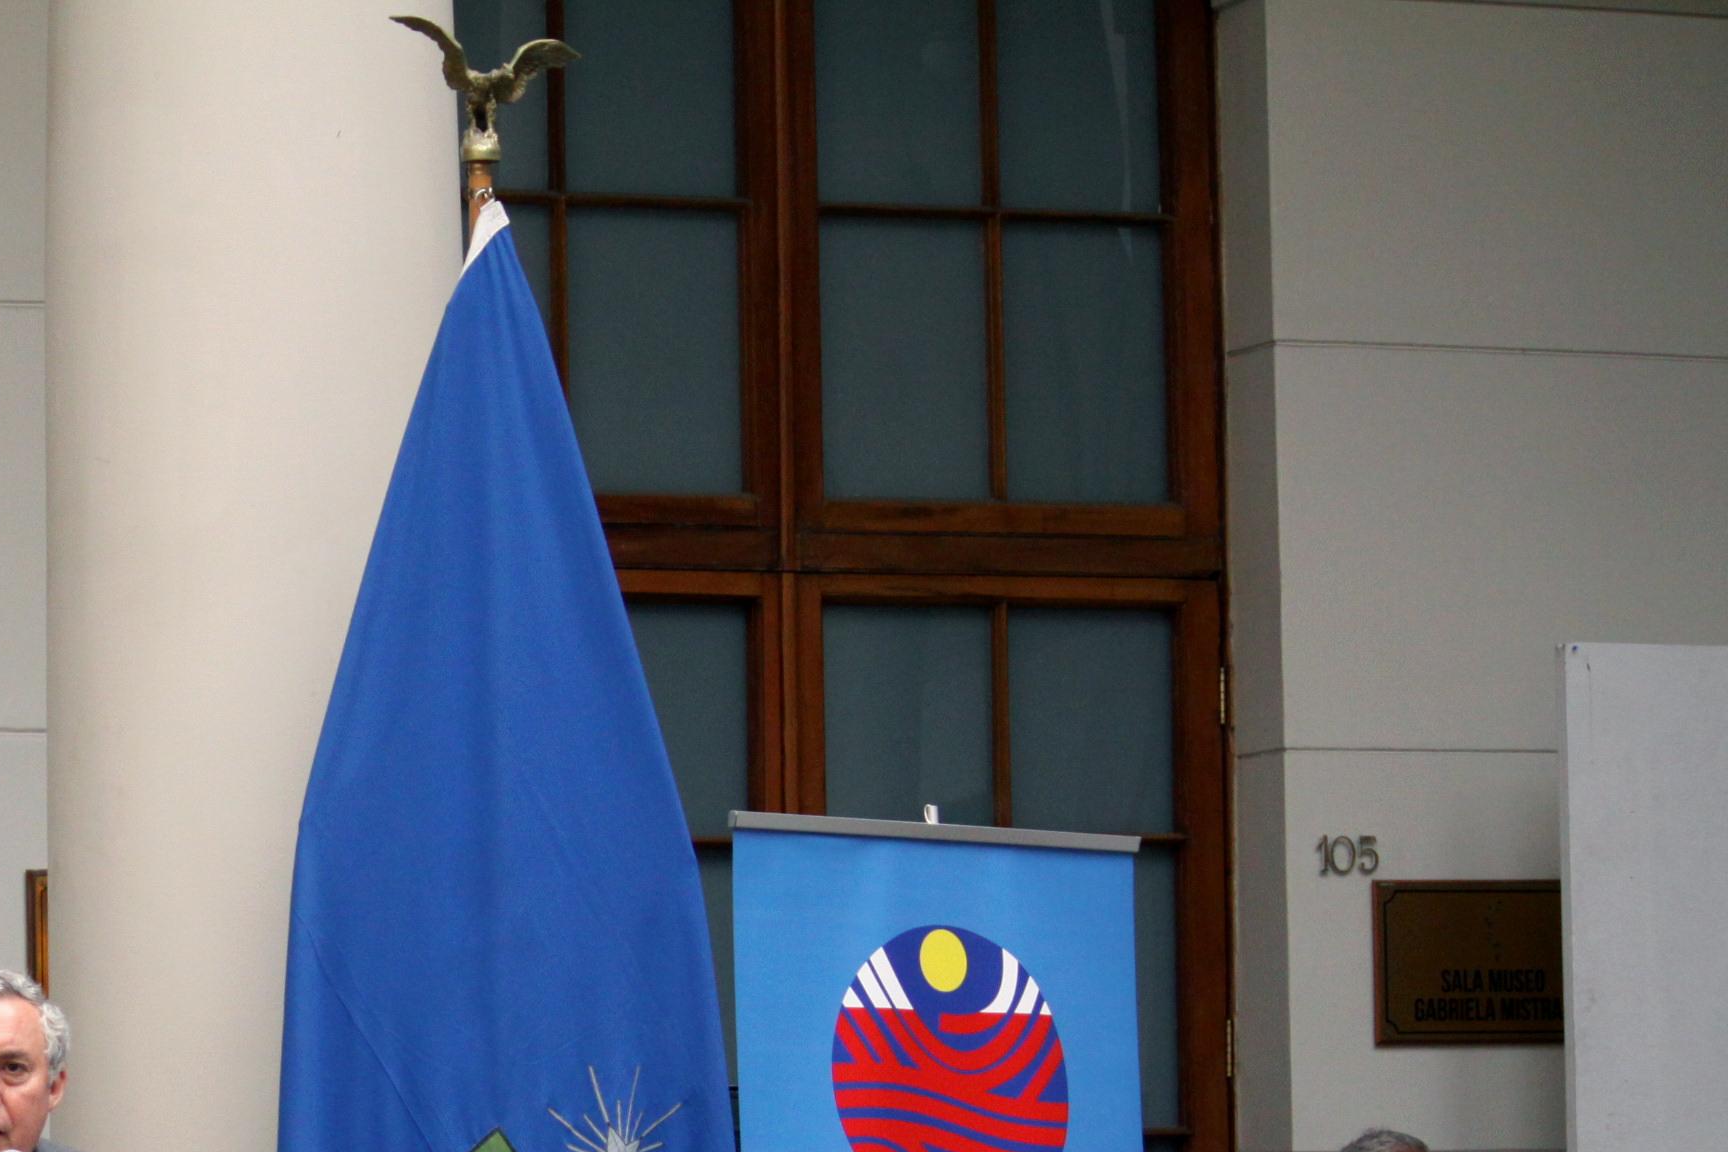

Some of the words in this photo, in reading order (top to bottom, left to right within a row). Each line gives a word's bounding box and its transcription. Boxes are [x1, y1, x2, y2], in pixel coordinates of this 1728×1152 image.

[1316, 834, 1379, 876] 105
[1441, 969, 1482, 992] SALA
[1488, 970, 1545, 992] MUSEO
[1414, 998, 1496, 1021] GABRIELA
